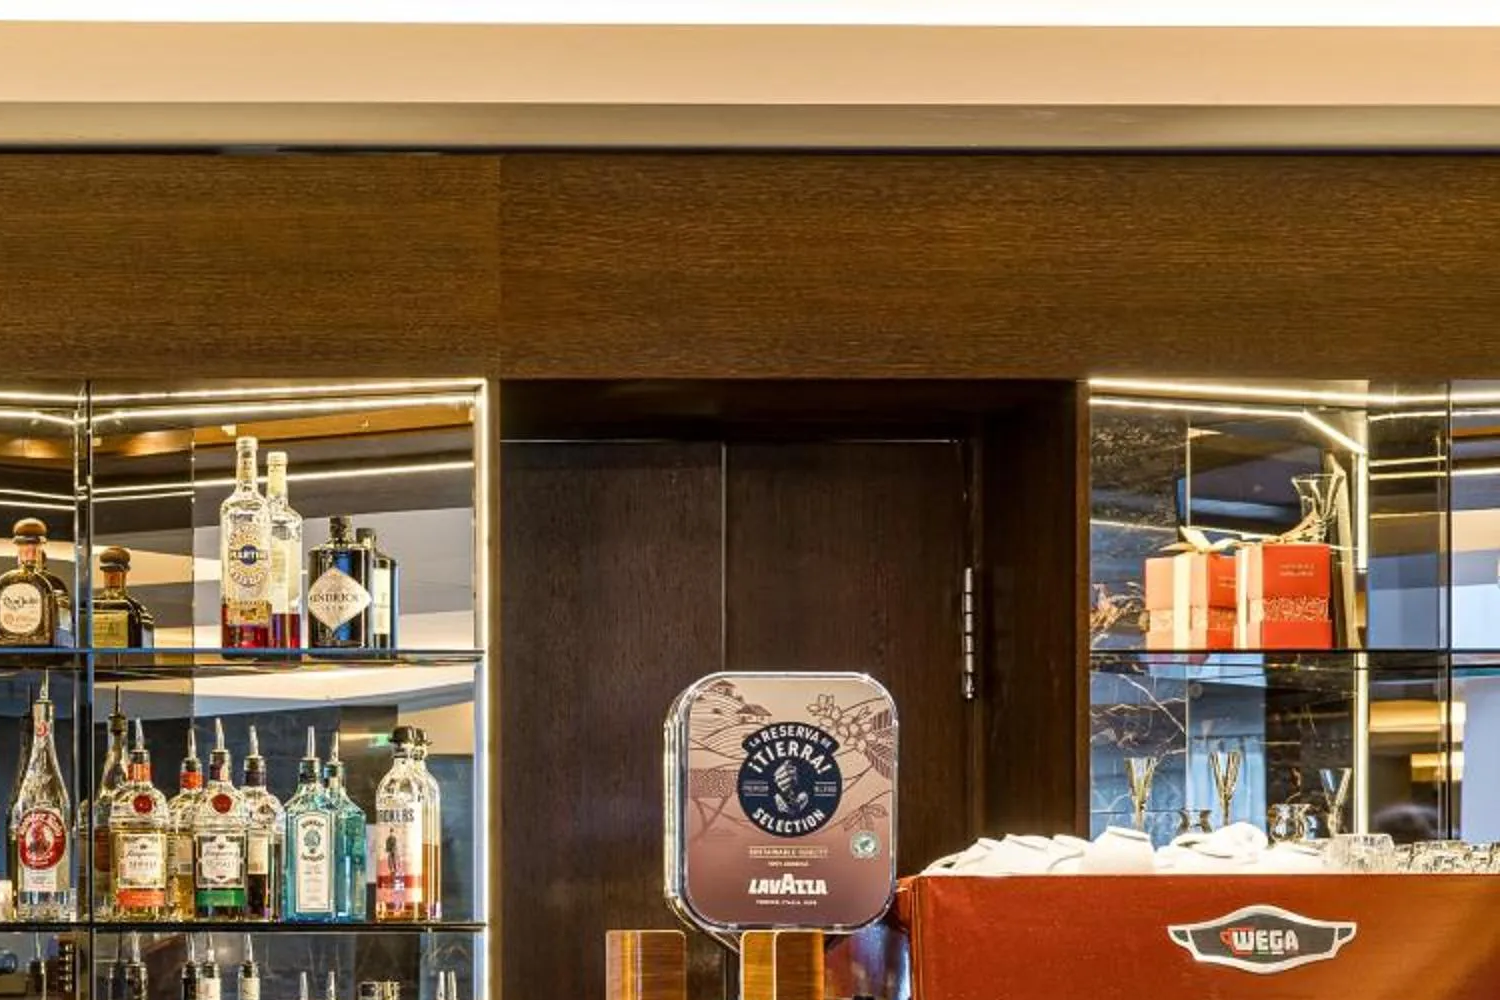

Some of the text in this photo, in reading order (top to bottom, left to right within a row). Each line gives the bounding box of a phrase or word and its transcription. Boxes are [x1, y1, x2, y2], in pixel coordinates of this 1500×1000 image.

[761, 725, 819, 743] RESERVA
[752, 807, 826, 833] SELECTION
[748, 873, 828, 895] LAVAZZA
[1232, 930, 1299, 951] WEGA
